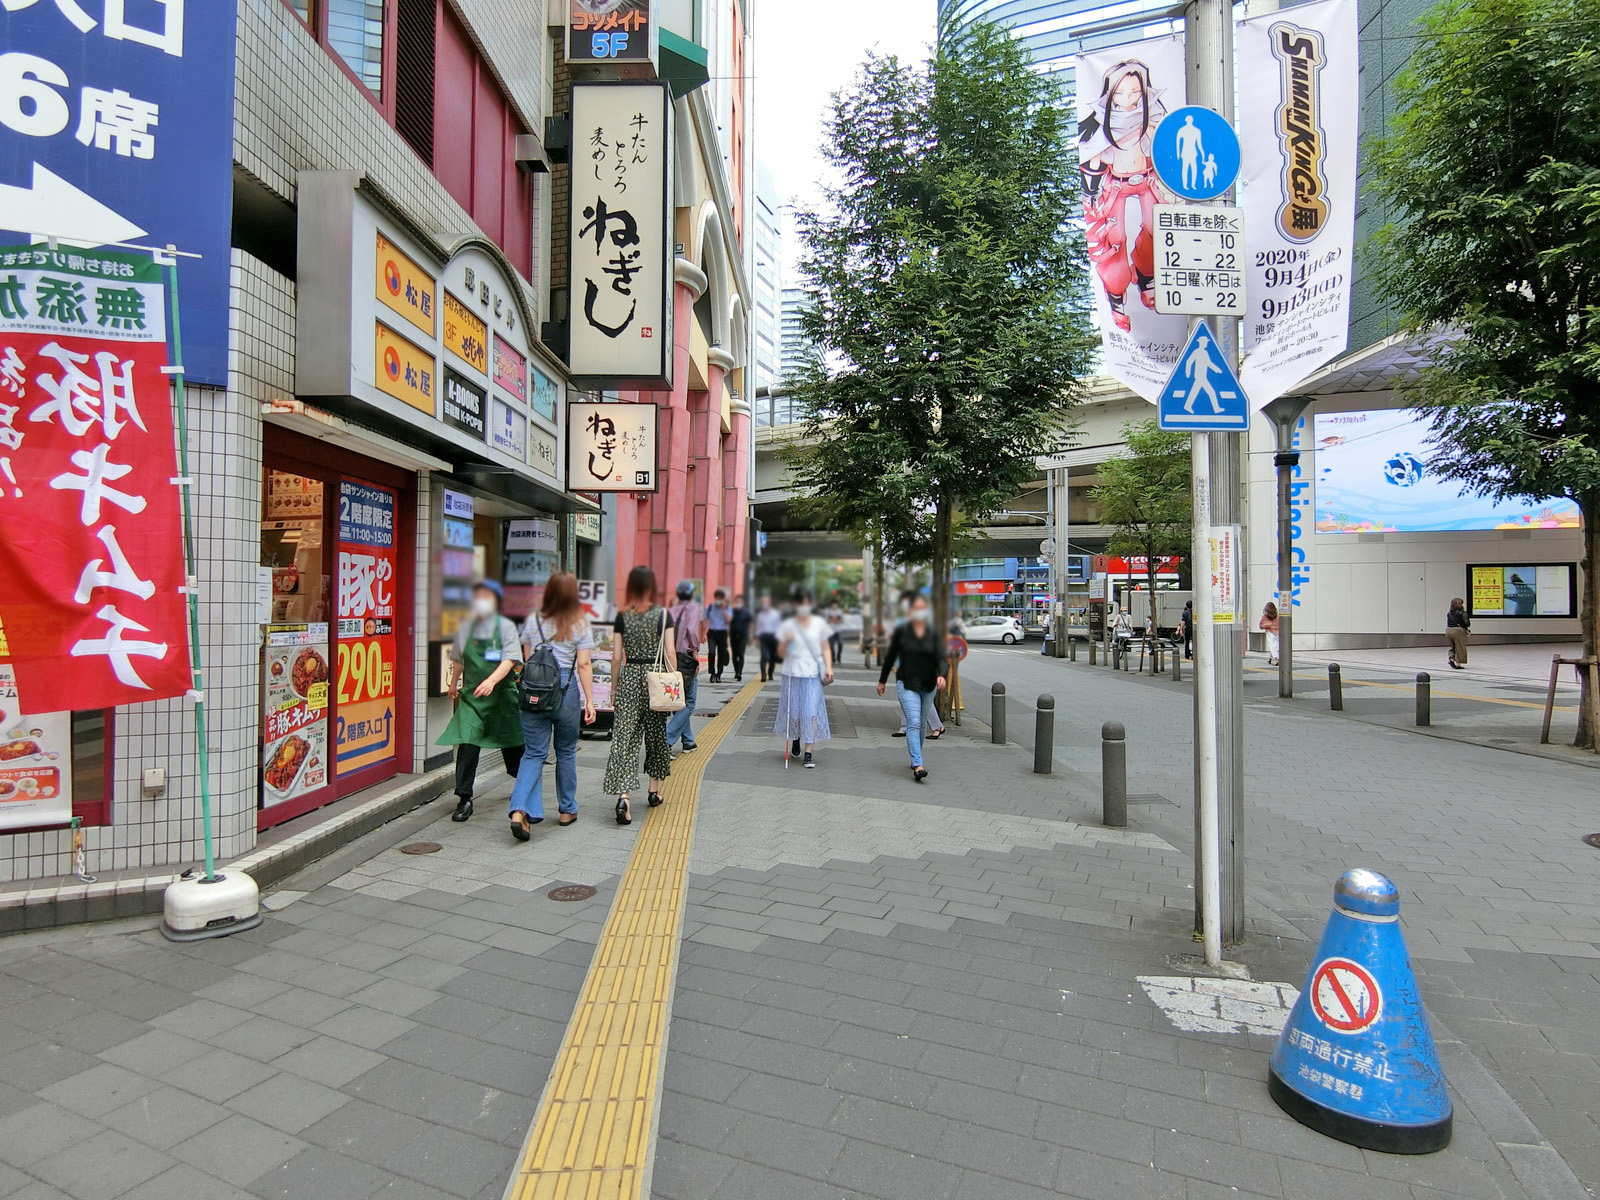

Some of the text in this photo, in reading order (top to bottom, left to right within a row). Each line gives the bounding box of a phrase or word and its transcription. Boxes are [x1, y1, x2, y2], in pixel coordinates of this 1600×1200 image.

[573, 10, 647, 32] コツメイト
[591, 33, 629, 58] 5F
[629, 113, 649, 164] 牛たん
[1280, 30, 1319, 231] SHAMAN KING 展
[589, 126, 610, 181] 麦めし
[614, 140, 627, 195] とろろ
[1159, 211, 1239, 230] 自転車を除く
[1165, 232, 1174, 247] 8
[1220, 234, 1235, 249] 10
[1255, 248, 1311, 267] 2020年
[578, 195, 644, 339] ねぎし
[1165, 251, 1181, 267] 12
[1215, 253, 1235, 269] 22
[1264, 247, 1342, 289] 9月4日(金)
[1160, 271, 1241, 288] 土・日曜、休日は
[1261, 273, 1343, 320] 9月13日(日)
[405, 278, 431, 319] 松屋
[1166, 290, 1182, 306] 10
[1216, 292, 1237, 308] 22
[446, 321, 457, 341] 3F
[405, 361, 431, 398] 松屋
[448, 378, 480, 415] K-BOOKS
[586, 411, 618, 482] ねぎし
[636, 473, 649, 484] B1
[340, 496, 392, 530] 2階席限定
[578, 582, 605, 600] 5F
[336, 715, 383, 745] 2階席入口
[1297, 1062, 1364, 1101] 池袋警察署
